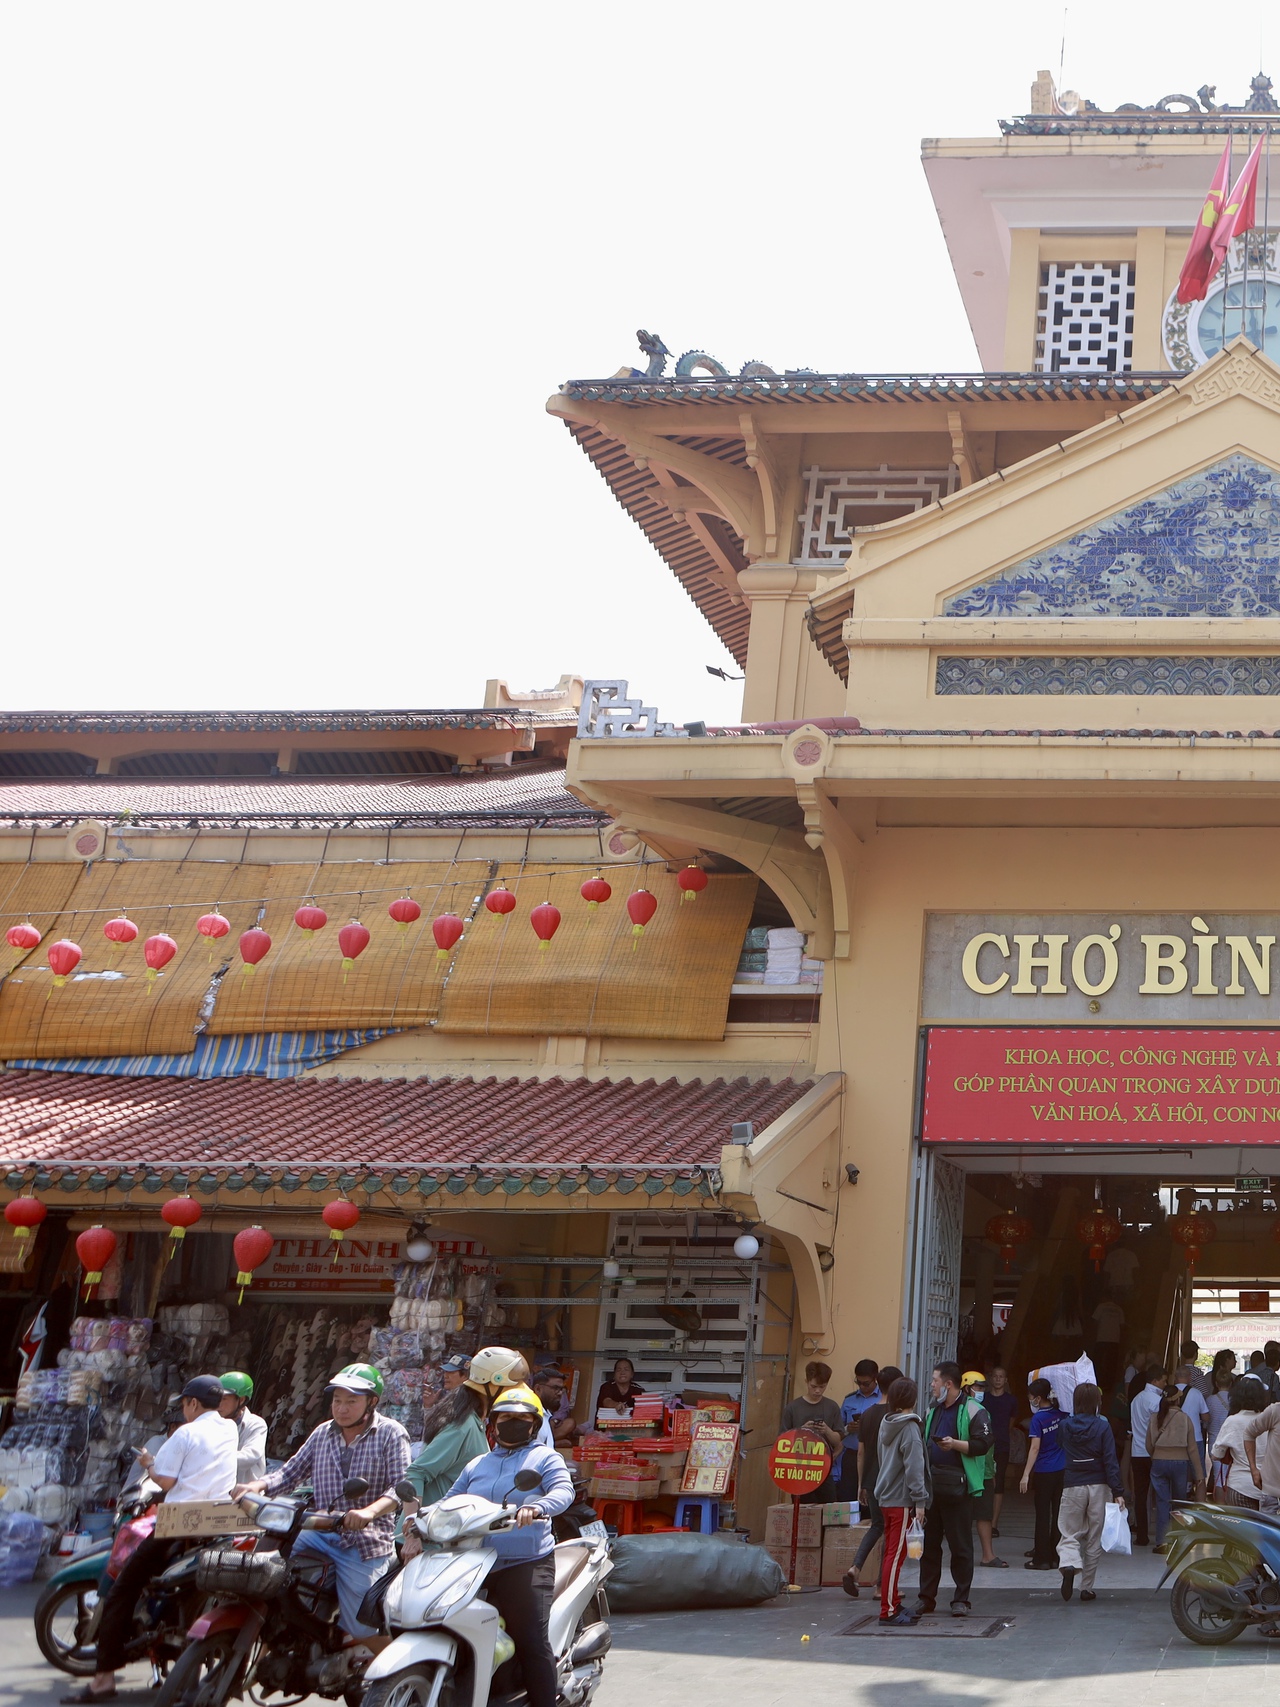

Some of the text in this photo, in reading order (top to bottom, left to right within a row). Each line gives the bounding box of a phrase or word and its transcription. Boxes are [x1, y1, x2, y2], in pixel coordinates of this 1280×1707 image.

[961, 924, 1121, 1013] CHỢ
[1004, 1048, 1063, 1066] KHOA
[1066, 1049, 1115, 1069] HỌC,
[1119, 1046, 1178, 1067] CÔNG
[1181, 1047, 1237, 1069] NGHỆ
[1242, 1046, 1273, 1067] VÀ
[953, 1072, 995, 1093] GÓP
[998, 1072, 1055, 1094] PHẦN
[1058, 1077, 1117, 1098] QUAN
[1121, 1077, 1191, 1097] TRỌNG
[1195, 1074, 1242, 1095] XÂY
[1031, 1101, 1075, 1122] VĂN
[1079, 1101, 1128, 1125] HOÁ,
[1132, 1102, 1164, 1122] XÃ
[1166, 1101, 1209, 1125] HỘI,
[1213, 1105, 1257, 1124] CON
[777, 1436, 825, 1456] CẤM
[774, 1466, 823, 1484] XE VÀO CHỢ
[1211, 1514, 1242, 1524] VISION
